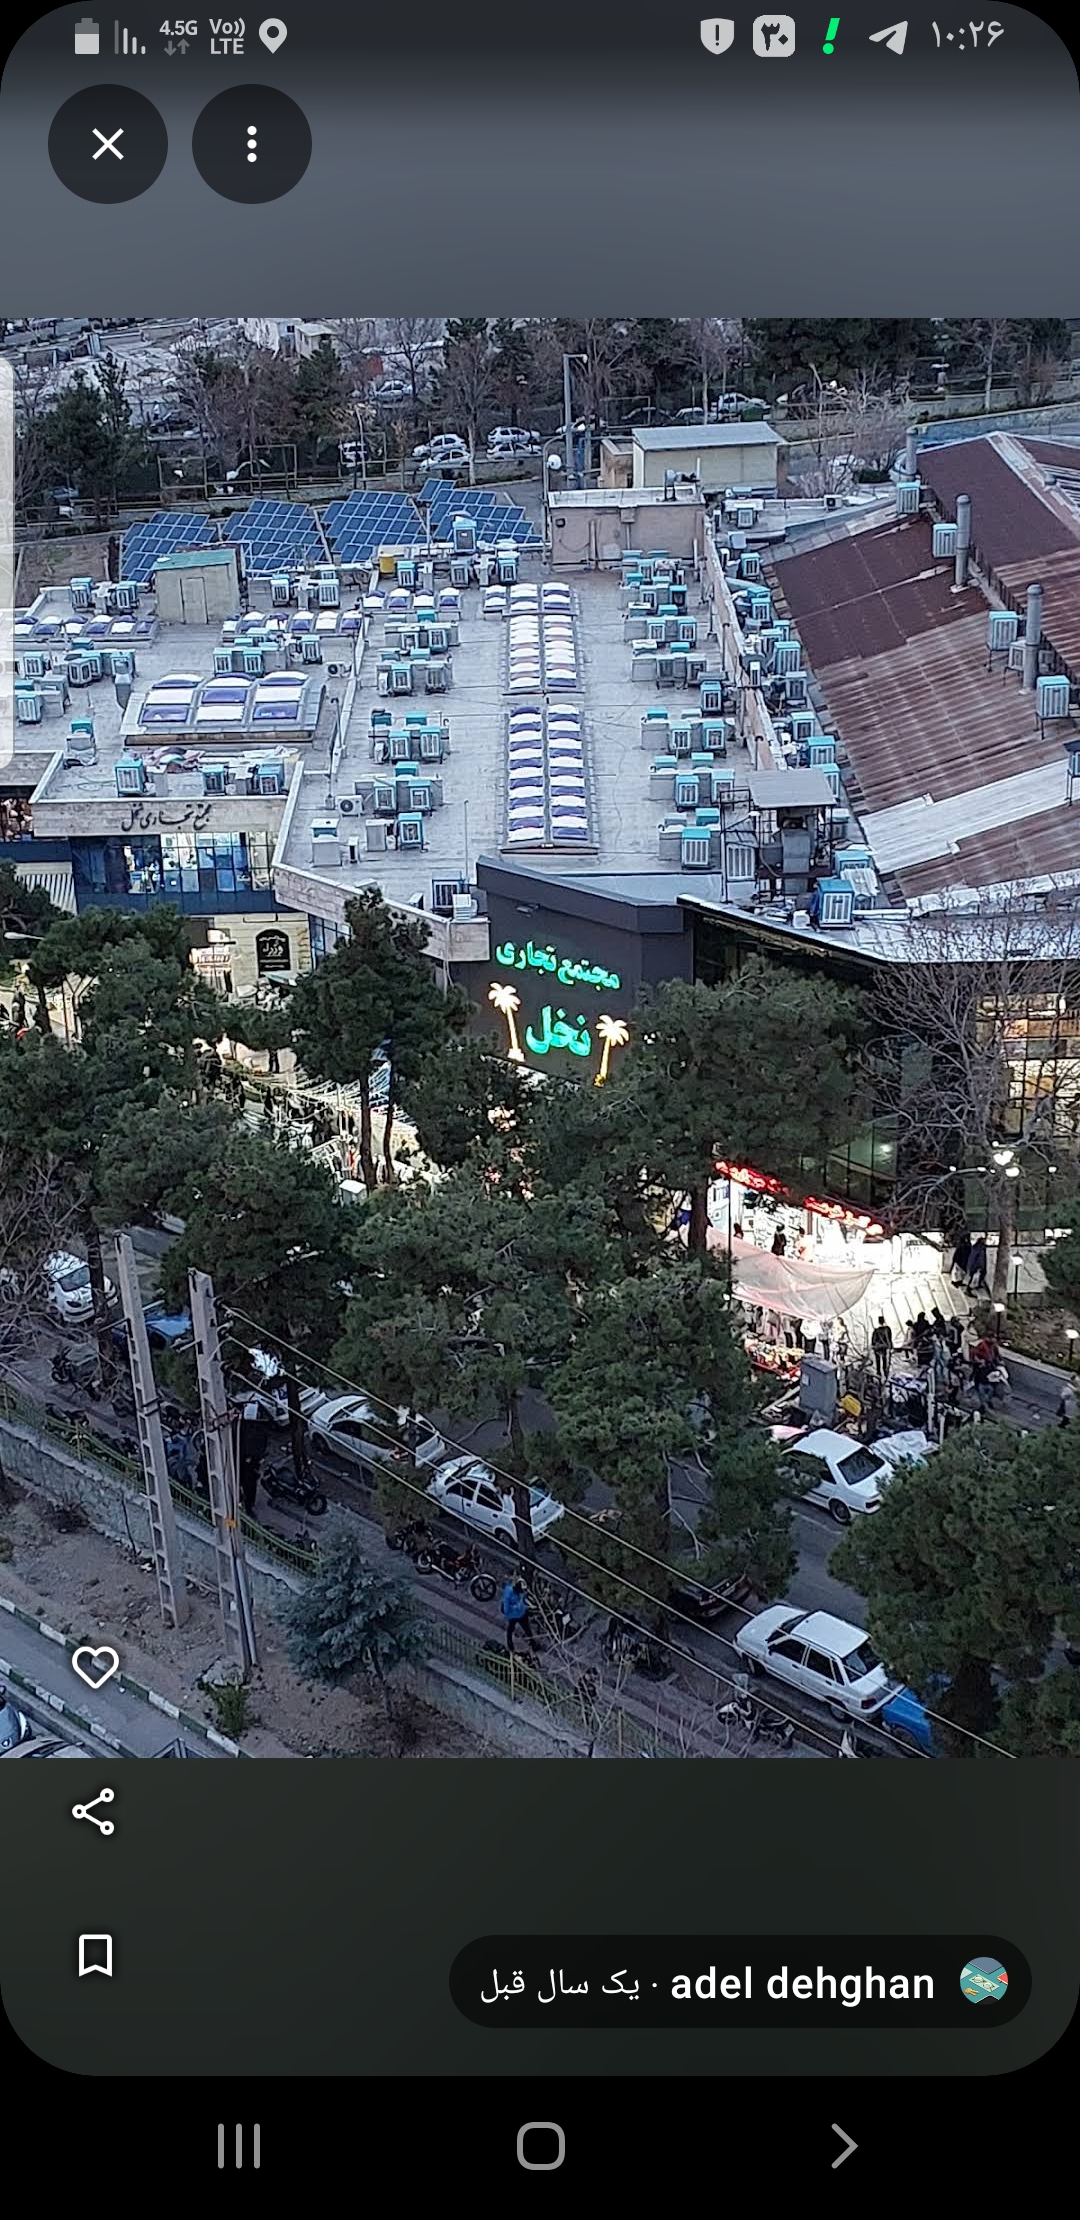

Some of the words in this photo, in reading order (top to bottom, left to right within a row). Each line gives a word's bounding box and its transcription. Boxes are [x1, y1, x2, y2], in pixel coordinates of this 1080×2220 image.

[496, 941, 557, 975] تجاری
[557, 959, 621, 991] مجتمع
[525, 1005, 592, 1056] نخل
